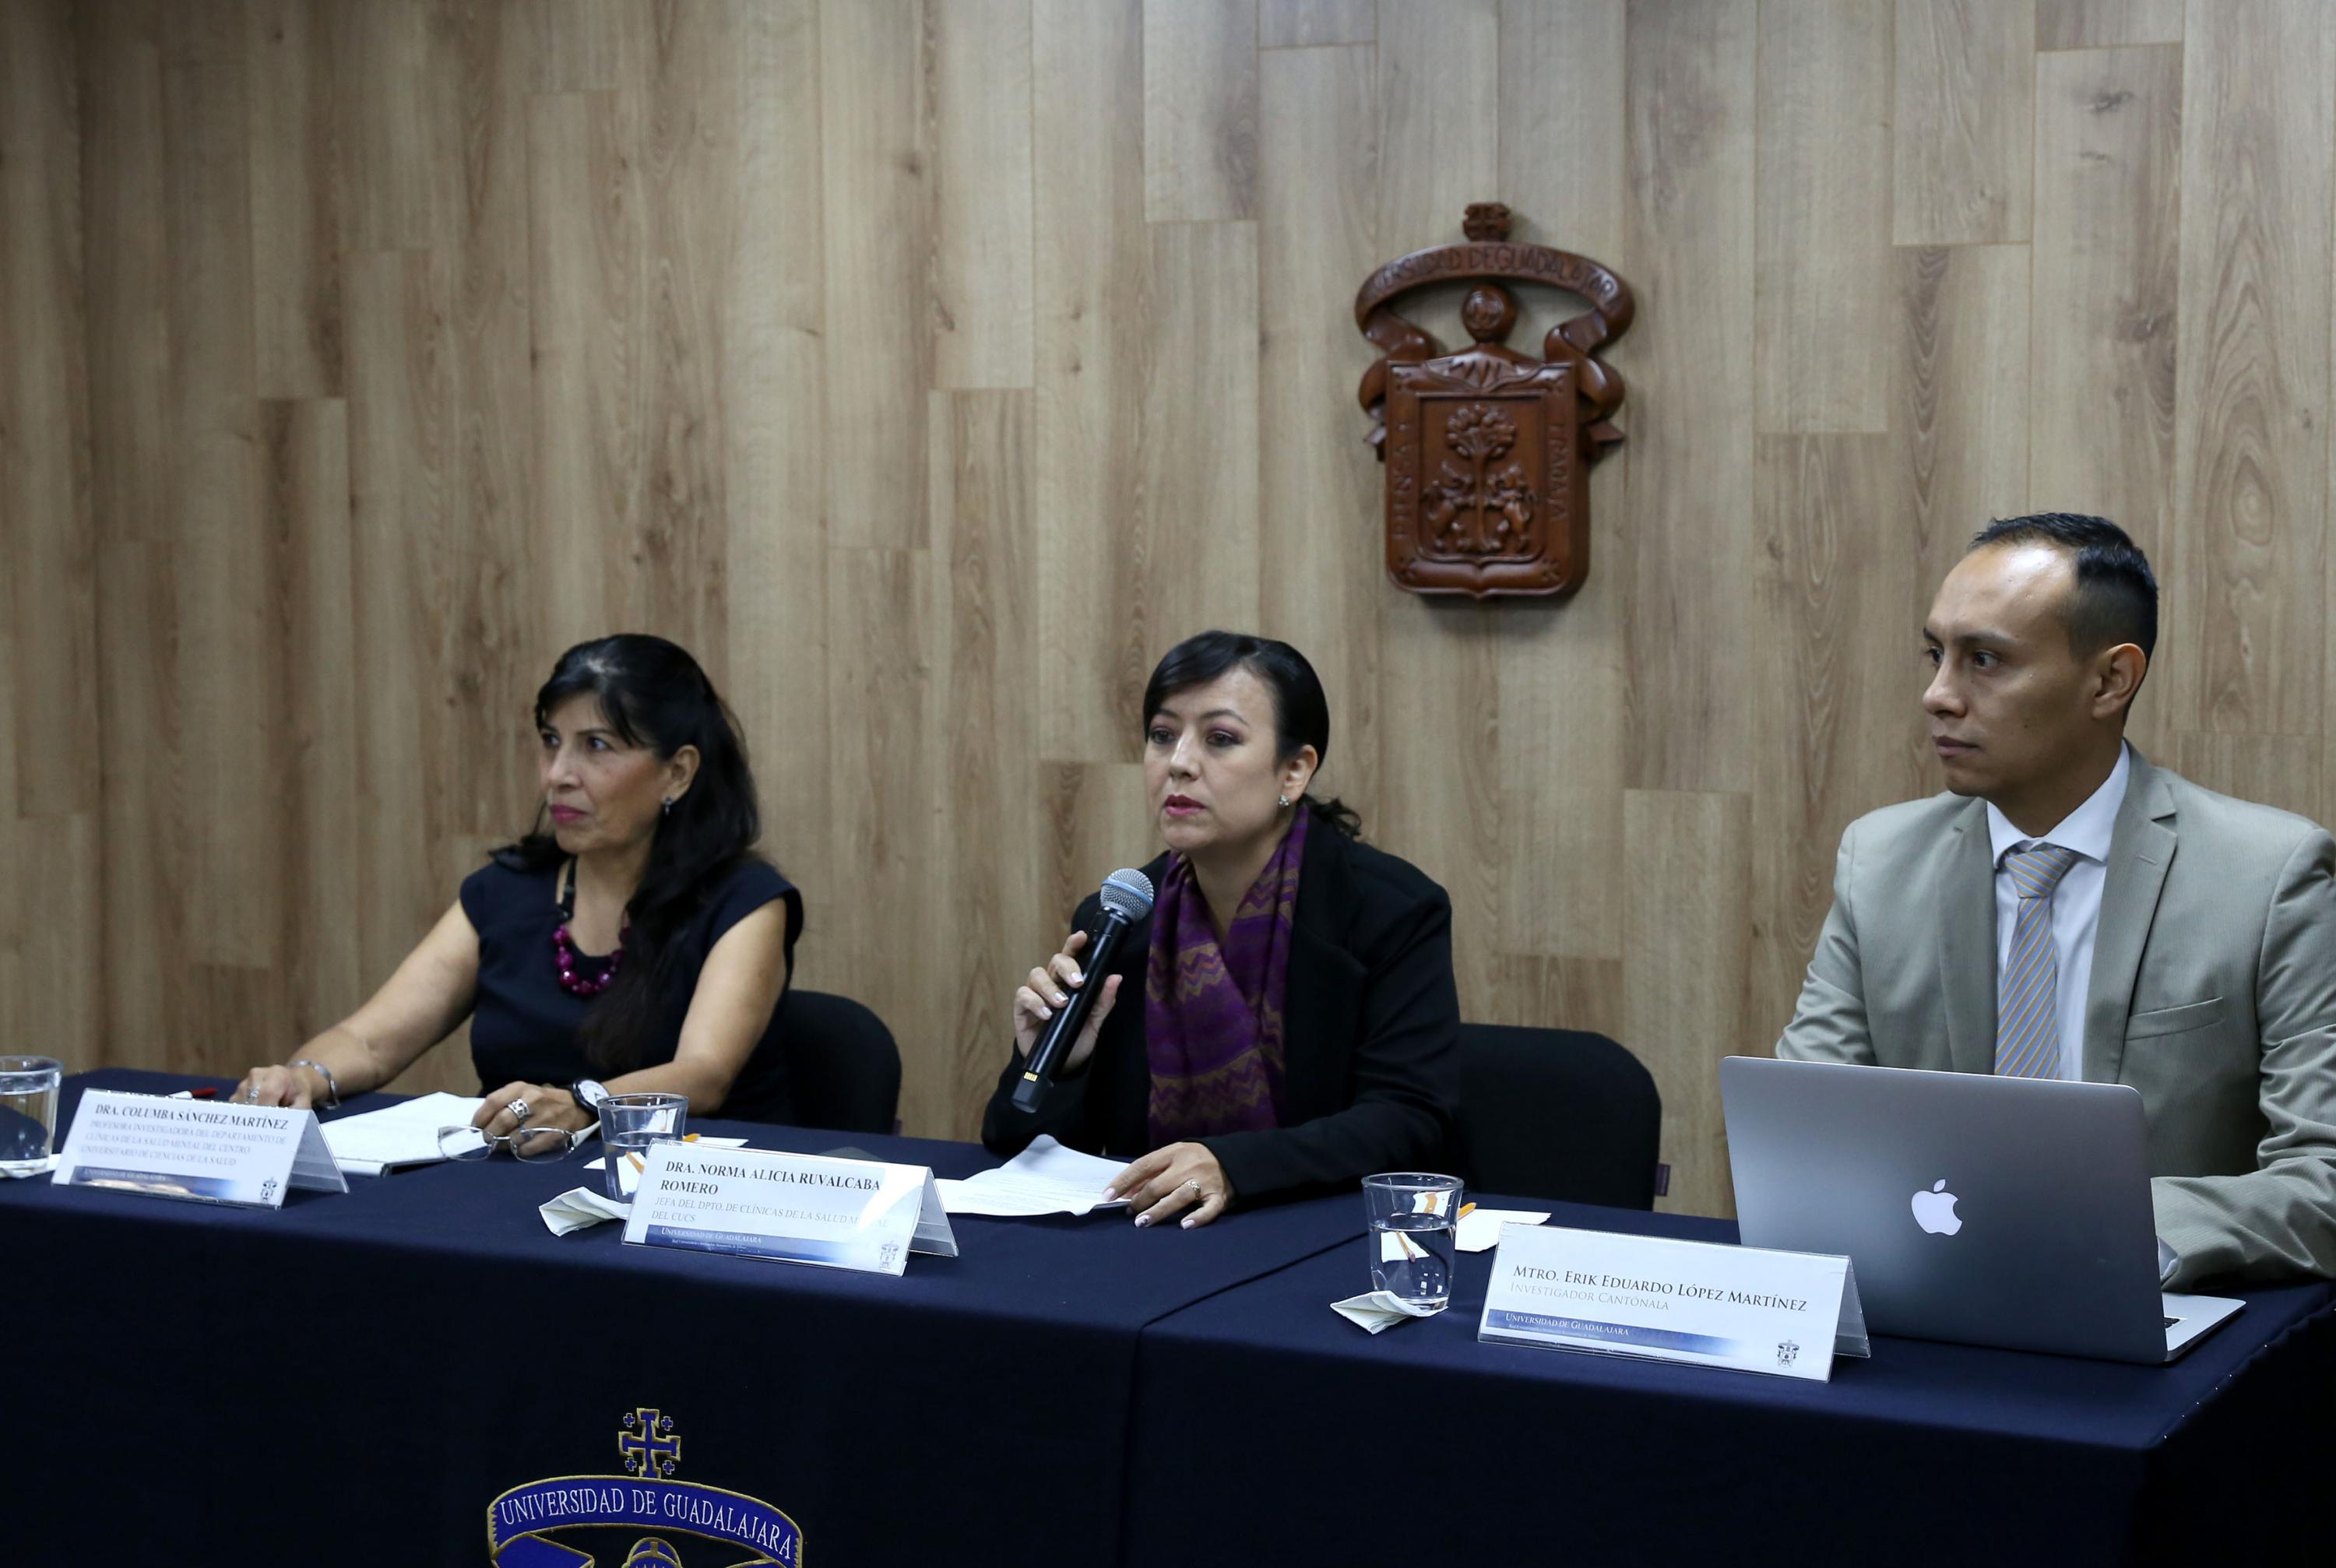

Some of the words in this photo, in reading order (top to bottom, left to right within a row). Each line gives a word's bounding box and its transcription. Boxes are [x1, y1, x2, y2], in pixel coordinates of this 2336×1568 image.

[95, 1103, 119, 1116] DRA.
[121, 1106, 174, 1121] COLUMBA
[176, 1109, 228, 1125] SÁNCHEZ
[231, 1115, 289, 1130] MARTÍNEZ
[660, 1180, 719, 1195] ROMERO
[666, 1161, 695, 1174] DRA.
[698, 1164, 745, 1178] NORMA
[749, 1168, 795, 1183] ALICIA
[799, 1172, 881, 1191] RUVALCABA
[651, 1210, 669, 1220] DEL
[671, 1212, 696, 1223] CUCS
[655, 1197, 676, 1207] JEFA
[678, 1198, 696, 1208] DEL
[698, 1201, 723, 1211] DPTO.
[725, 1203, 739, 1212] DE
[740, 1203, 783, 1218] CLÍNICAS
[785, 1209, 798, 1218] DE
[800, 1211, 813, 1220] LA
[814, 1212, 847, 1224] SALUD
[1513, 1264, 1559, 1281] MTRO.
[1564, 1270, 1597, 1286] ERIK
[1602, 1274, 1673, 1295] EDUARDO
[1677, 1283, 1724, 1302] LÓPEZ
[1727, 1290, 1807, 1312] MARTÍNEZ
[500, 1488, 624, 1525] UNIVERSIDAD
[632, 1489, 657, 1514] DE
[663, 1492, 791, 1560] GUADALAJARA
